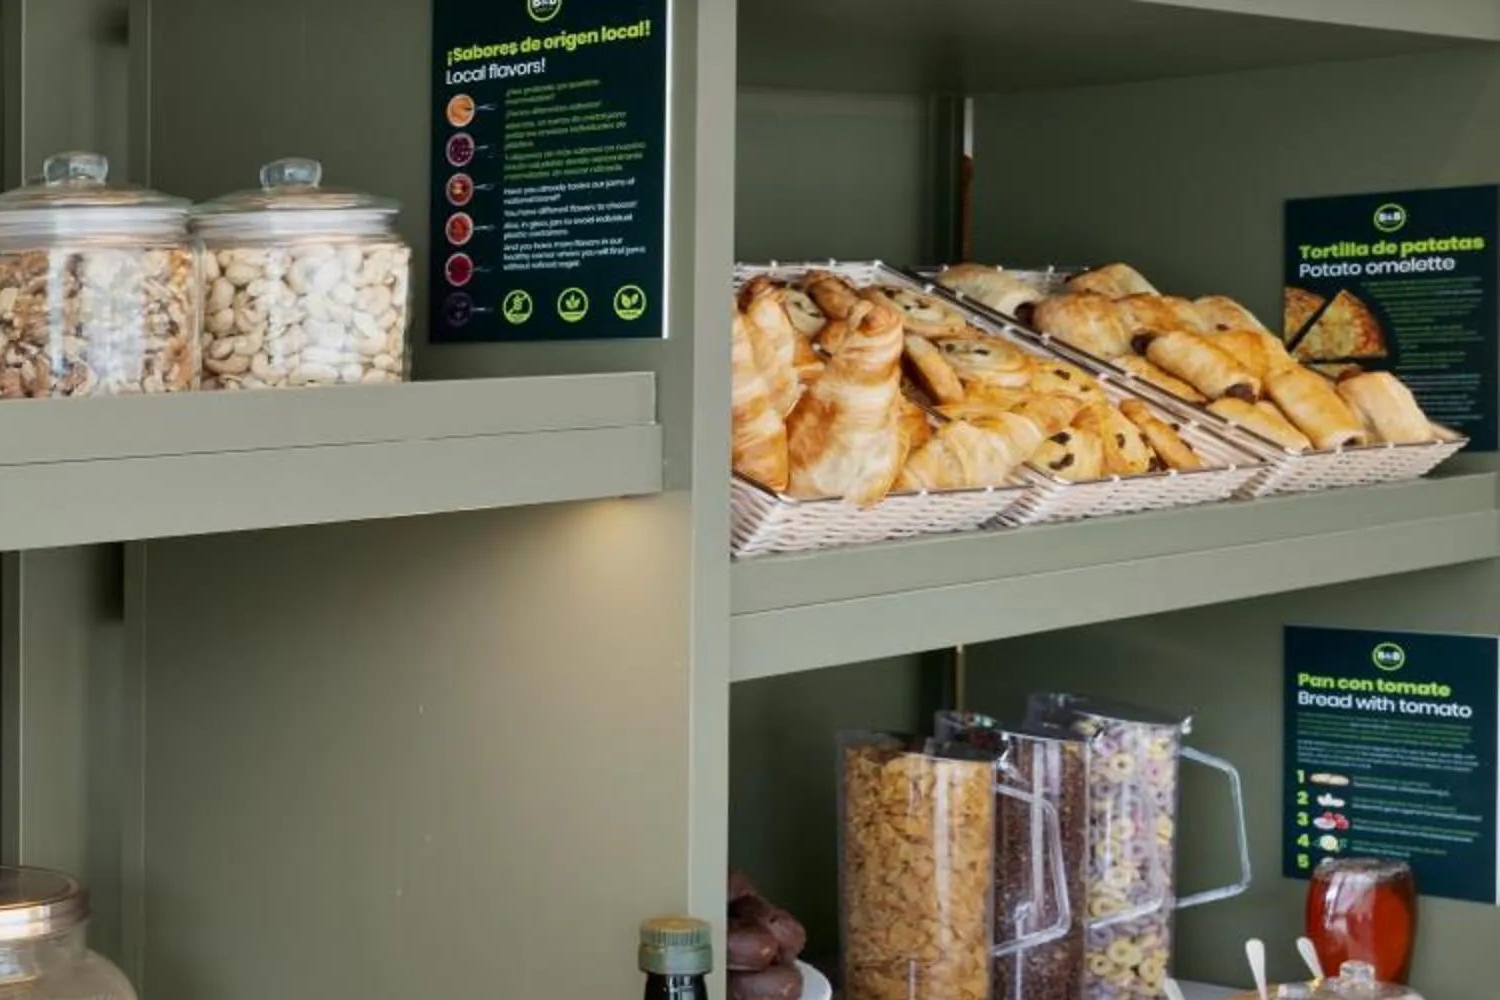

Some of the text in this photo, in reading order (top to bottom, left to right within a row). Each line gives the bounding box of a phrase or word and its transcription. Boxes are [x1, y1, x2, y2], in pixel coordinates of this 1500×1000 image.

[447, 19, 651, 66] ¡Sabores de origen local!
[446, 57, 546, 85] Local flavors!
[1299, 236, 1485, 259] Tortilla de patatas
[1300, 256, 1456, 278] Potato omelette
[1298, 672, 1451, 697] Pan con tomate
[1298, 691, 1473, 719] Bread with tomato
[1296, 769, 1305, 784] 1
[1297, 791, 1309, 805] 2
[1297, 811, 1308, 826] 3
[1297, 833, 1310, 847] 4
[1297, 853, 1309, 868] 5
